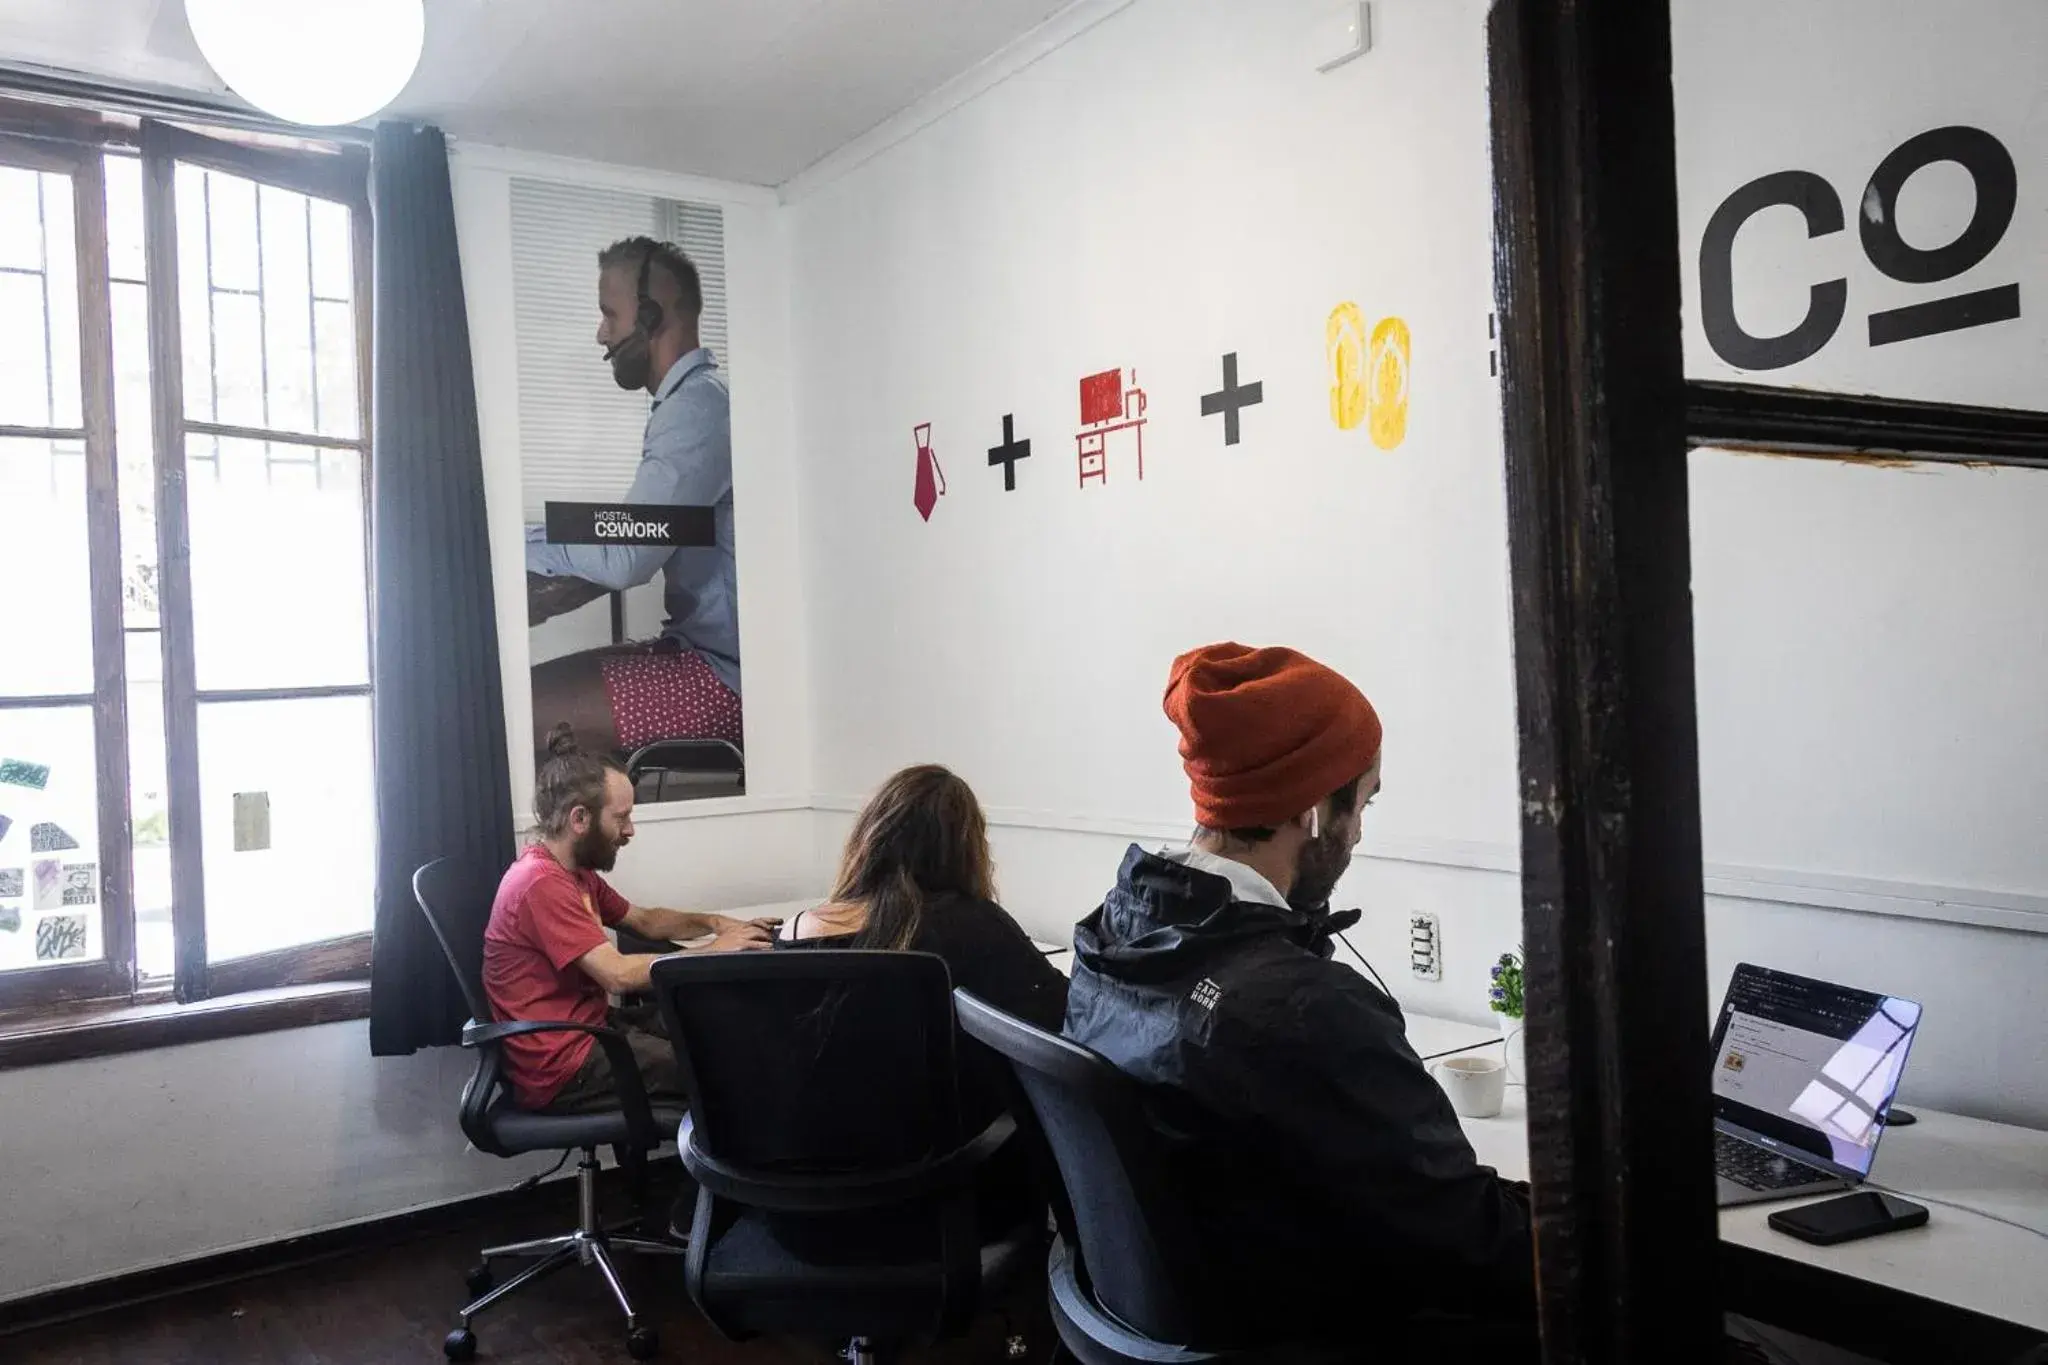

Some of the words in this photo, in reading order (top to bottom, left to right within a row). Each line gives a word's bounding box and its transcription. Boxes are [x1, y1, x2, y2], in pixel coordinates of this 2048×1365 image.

[594, 511, 634, 522] HOSTAL
[1190, 990, 1216, 1010] HORN
[1195, 982, 1221, 1001] CAPE
